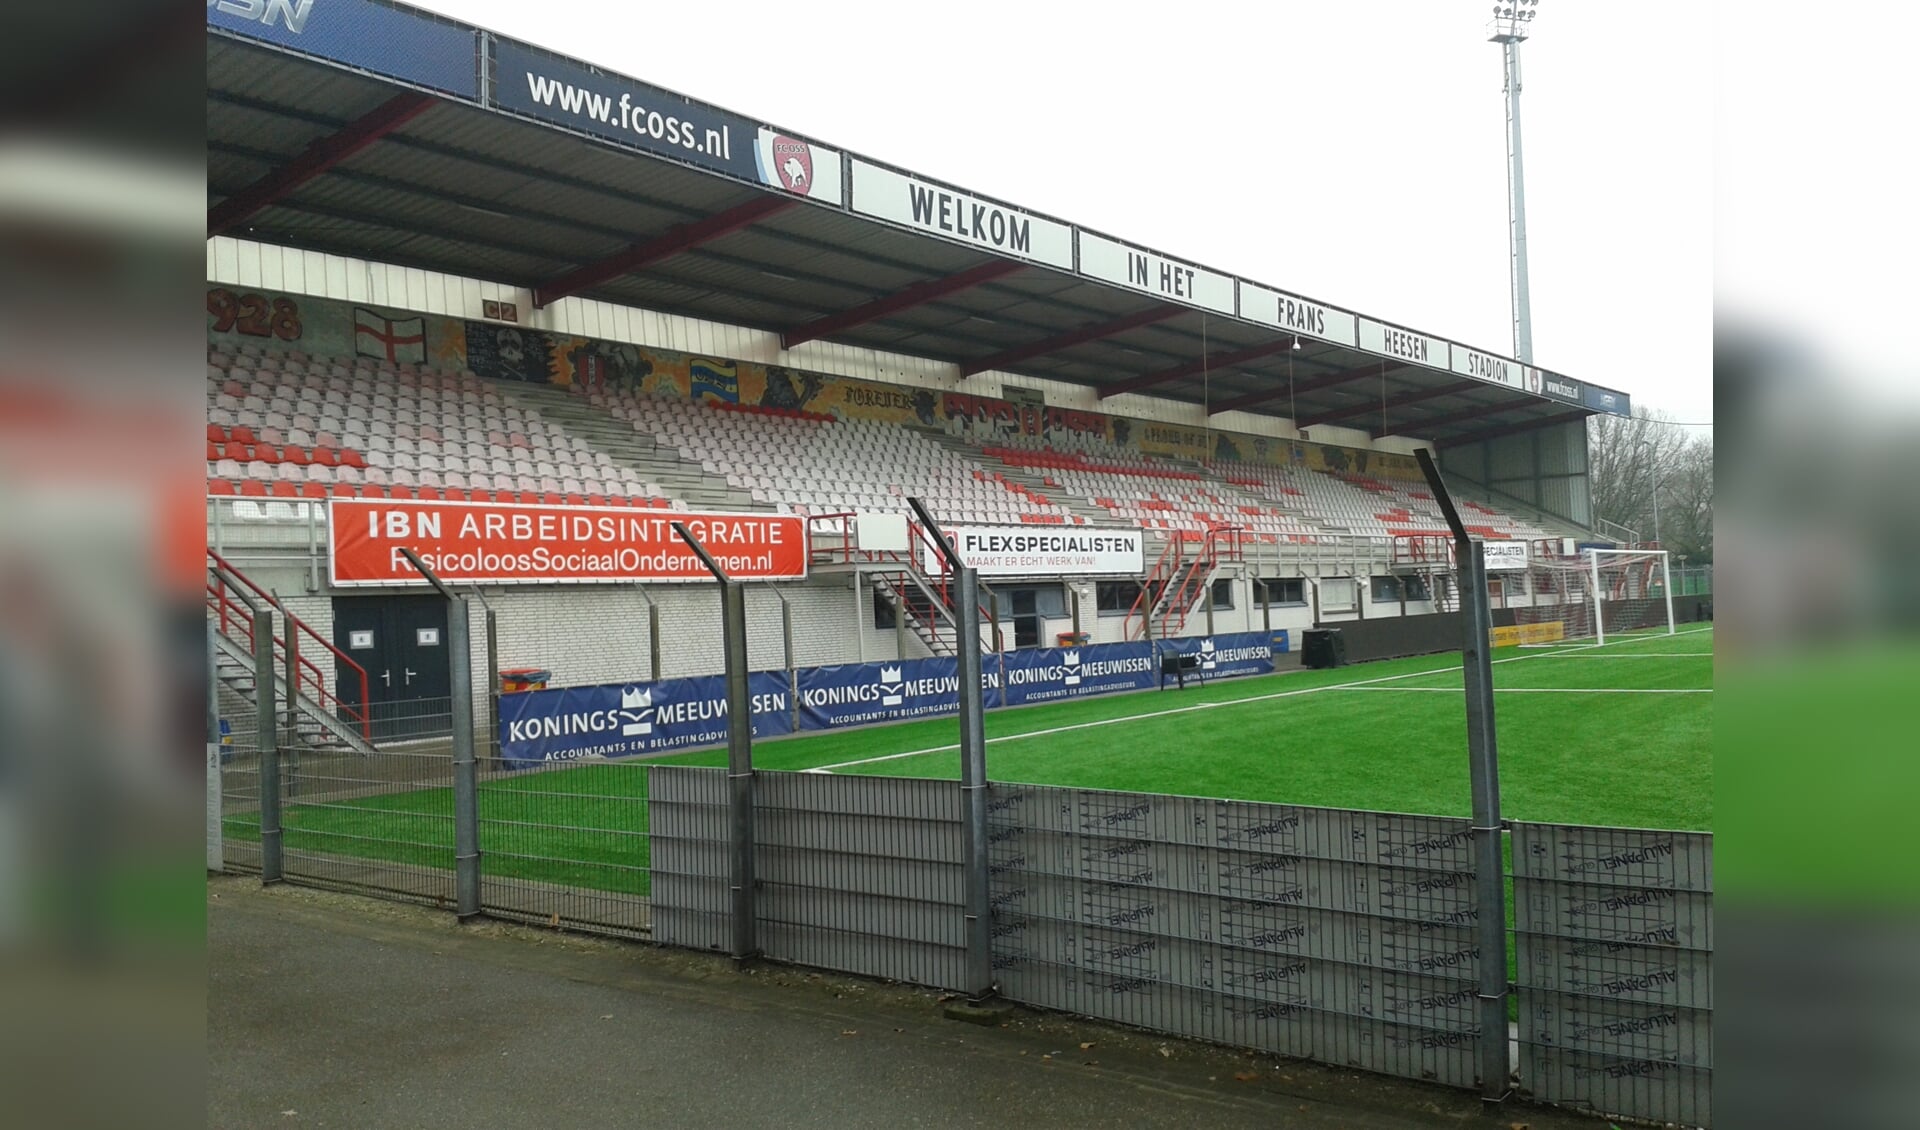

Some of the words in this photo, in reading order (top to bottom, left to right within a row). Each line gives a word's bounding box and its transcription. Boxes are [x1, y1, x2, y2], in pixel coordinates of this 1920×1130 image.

[525, 70, 731, 161] www.fcoss.nl
[776, 144, 789, 153] FC
[788, 144, 806, 153] OSS
[908, 182, 1031, 254] WELKOM
[1127, 251, 1149, 288] IN
[1159, 260, 1195, 300] HET
[1277, 297, 1325, 336] FRANS
[1383, 328, 1428, 363] HEESEN
[1468, 352, 1509, 384] STADION
[368, 510, 441, 539] IBN
[458, 512, 783, 545] ARBEIDSINTEGRATIE
[966, 535, 1135, 553] FLEXSPECIALISTEN
[390, 546, 773, 572] RsicoloosSociaalOndernmen.nl
[966, 556, 1001, 567] MAAKT
[1005, 556, 1018, 567] ER
[1047, 556, 1073, 566] WERK
[1075, 556, 1096, 566] VAN!
[1215, 646, 1271, 664] MEEUWISSEN
[1008, 665, 1063, 686] KONINGS
[1081, 656, 1151, 678] MEEUWISSEN
[804, 683, 880, 707] KONINGS
[905, 672, 999, 698] MEEUWEN
[1026, 689, 1067, 700] ACCOUNTANTS
[1069, 688, 1077, 696] EN
[508, 709, 619, 743] KONINGS
[655, 692, 786, 725] MEEUWSEN
[829, 711, 886, 725] ACCOUNTANTS
[889, 709, 898, 718] EN
[901, 702, 961, 717] BELASTINGADVIS
[545, 742, 626, 761] ACCOUNTANTS
[630, 740, 645, 751] EN
[650, 726, 758, 749] BELASTINGADVIS
[987, 793, 1023, 814] ALUPANE
[1103, 803, 1150, 826] ALUPANEL
[1243, 816, 1299, 840] ALUPANEL
[1411, 832, 1475, 855] ALUPANEL
[1600, 842, 1672, 870] ALUPANEL
[1109, 905, 1155, 926] ALUPANEL
[1251, 925, 1305, 947] ALUPANEL
[1109, 940, 1156, 960] ALUPANEL
[1416, 948, 1480, 971] ALUPANEL
[1251, 963, 1306, 983] ALUPANEL
[1604, 970, 1676, 995] ALUPANEL
[1416, 988, 1481, 1010] ALUPANEL
[1604, 1012, 1677, 1037] ALUPANEL
